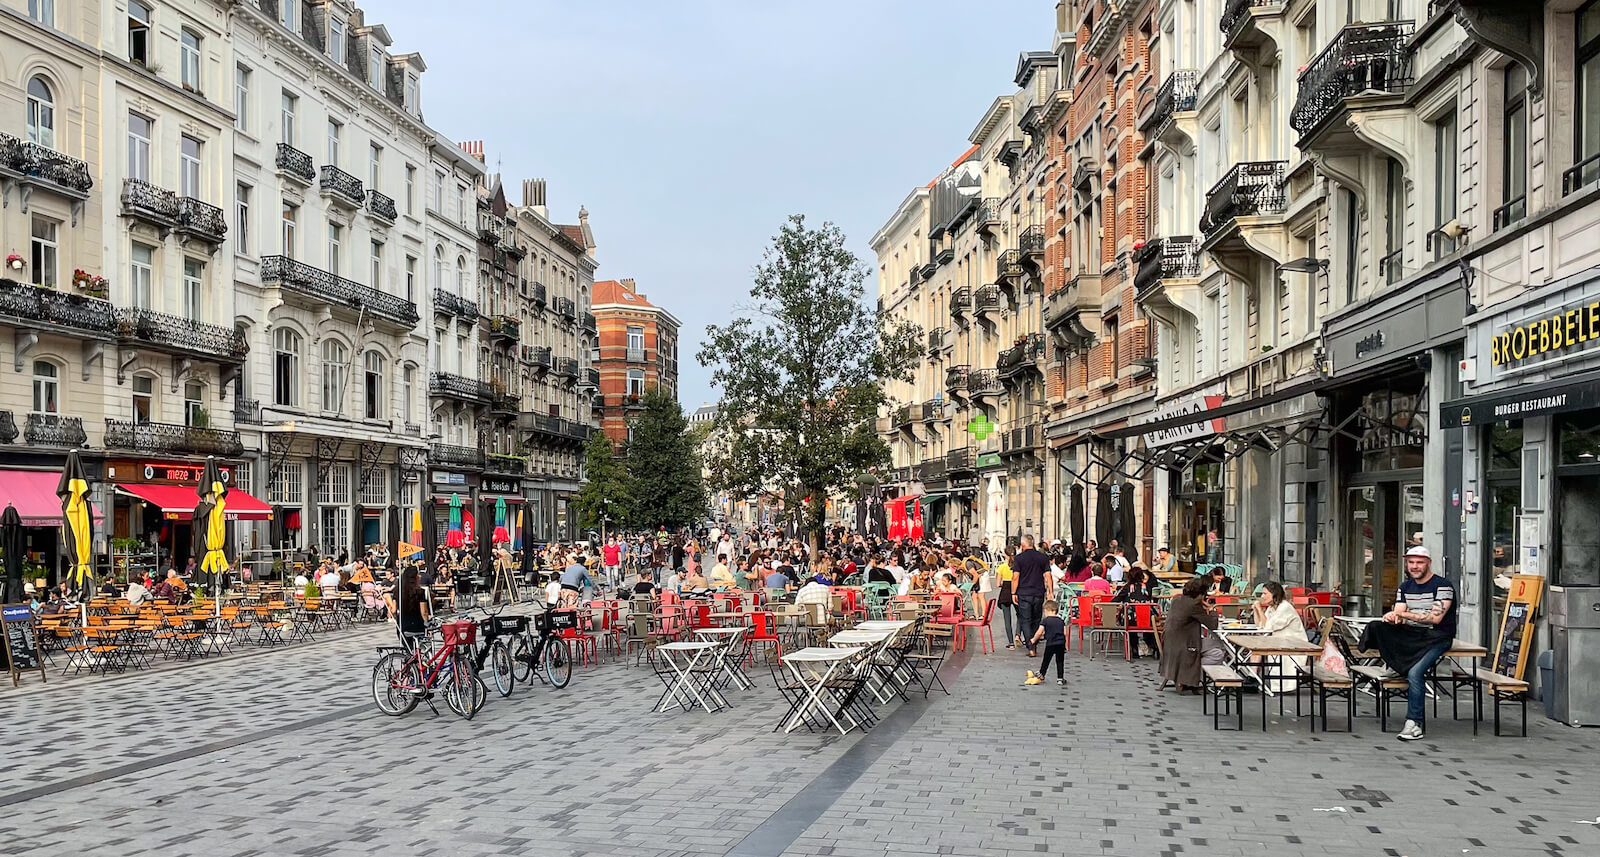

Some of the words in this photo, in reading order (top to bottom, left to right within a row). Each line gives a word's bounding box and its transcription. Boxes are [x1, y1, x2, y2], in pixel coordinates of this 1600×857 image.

[1491, 302, 1600, 366] BROEBBELE
[1495, 403, 1519, 415] BURGER
[1521, 394, 1567, 411] RESTAURANT
[167, 469, 188, 480] meze
